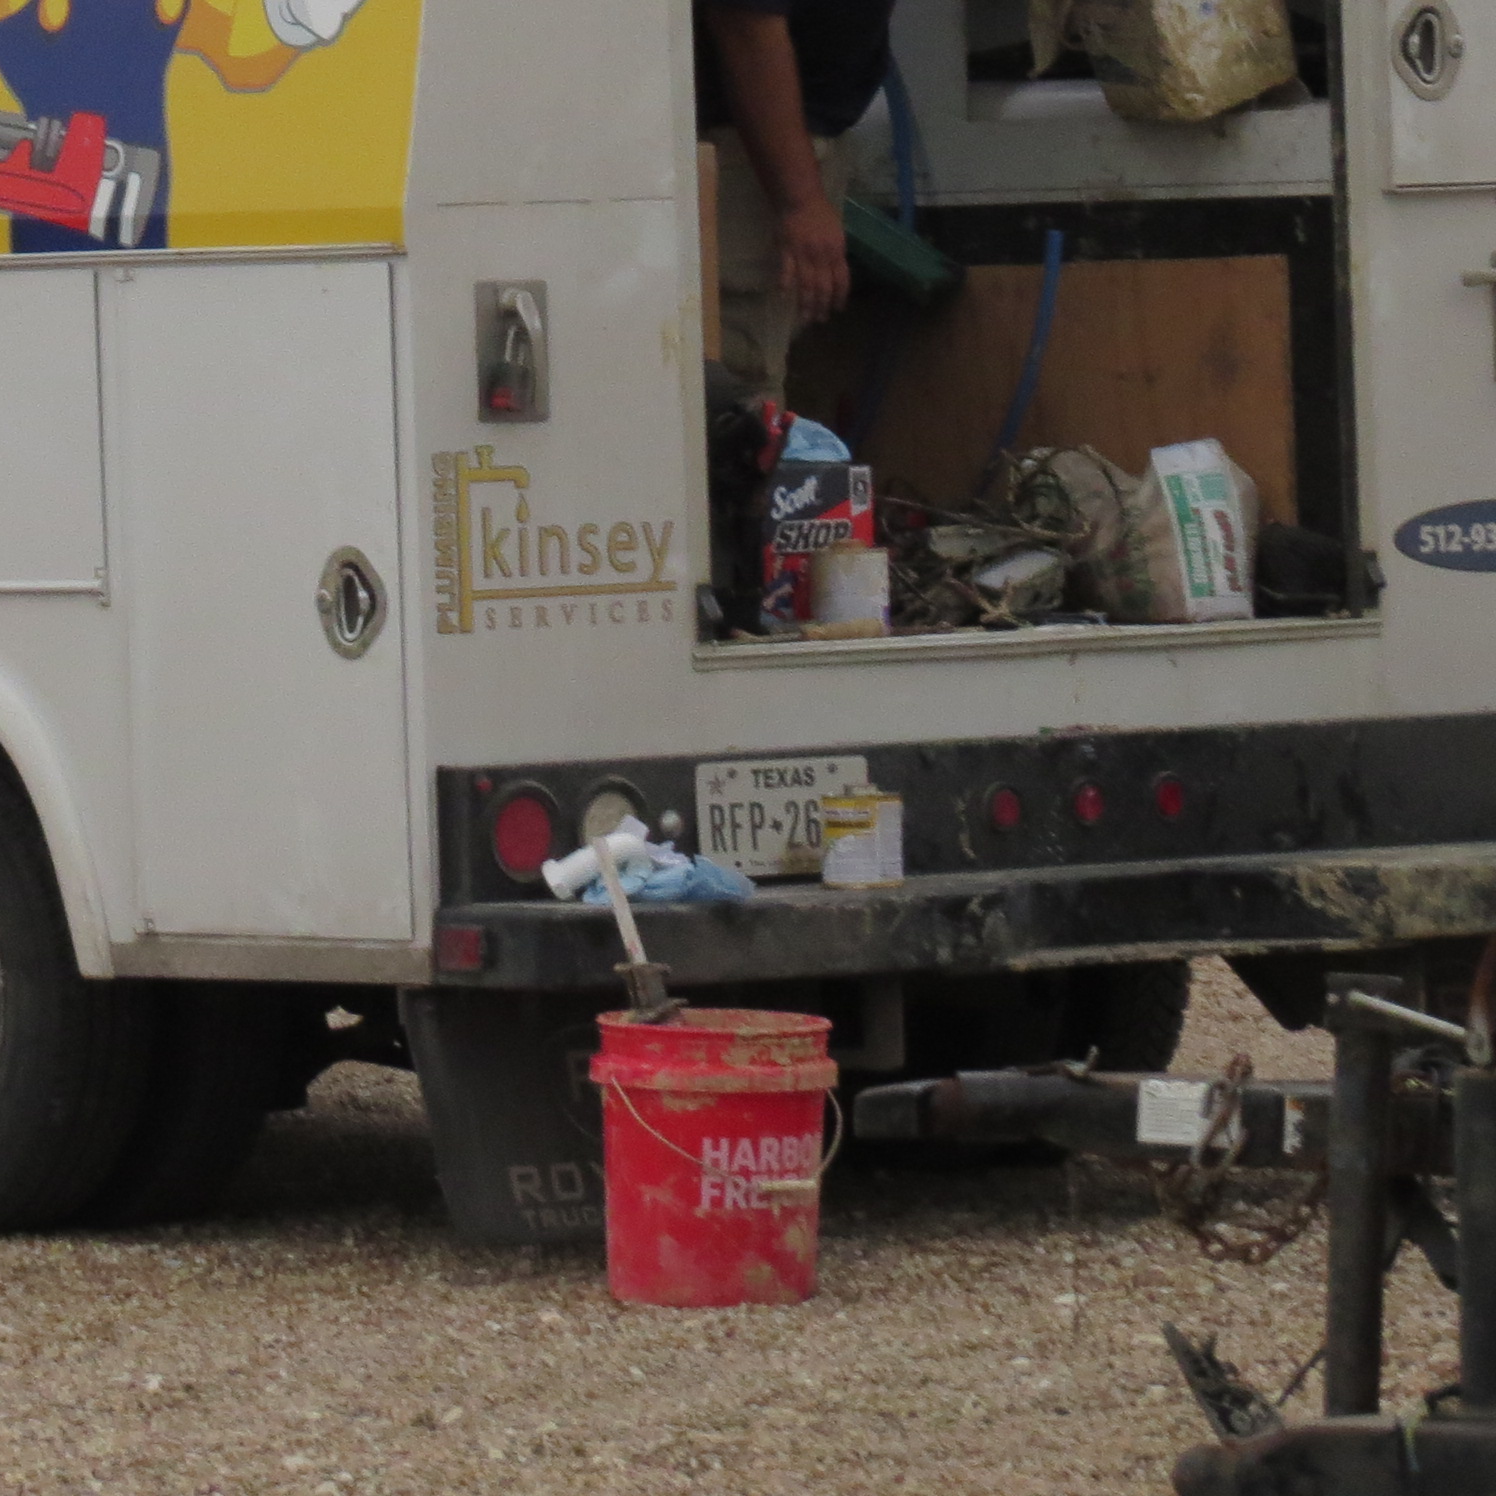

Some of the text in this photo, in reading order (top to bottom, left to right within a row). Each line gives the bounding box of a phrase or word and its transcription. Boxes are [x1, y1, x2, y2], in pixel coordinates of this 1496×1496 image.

[480, 505, 675, 583] kinsey
[772, 518, 853, 554] SHOP
[484, 598, 675, 631] SERVICES
[752, 766, 817, 790] TEXAS
[509, 1161, 606, 1204] RO
